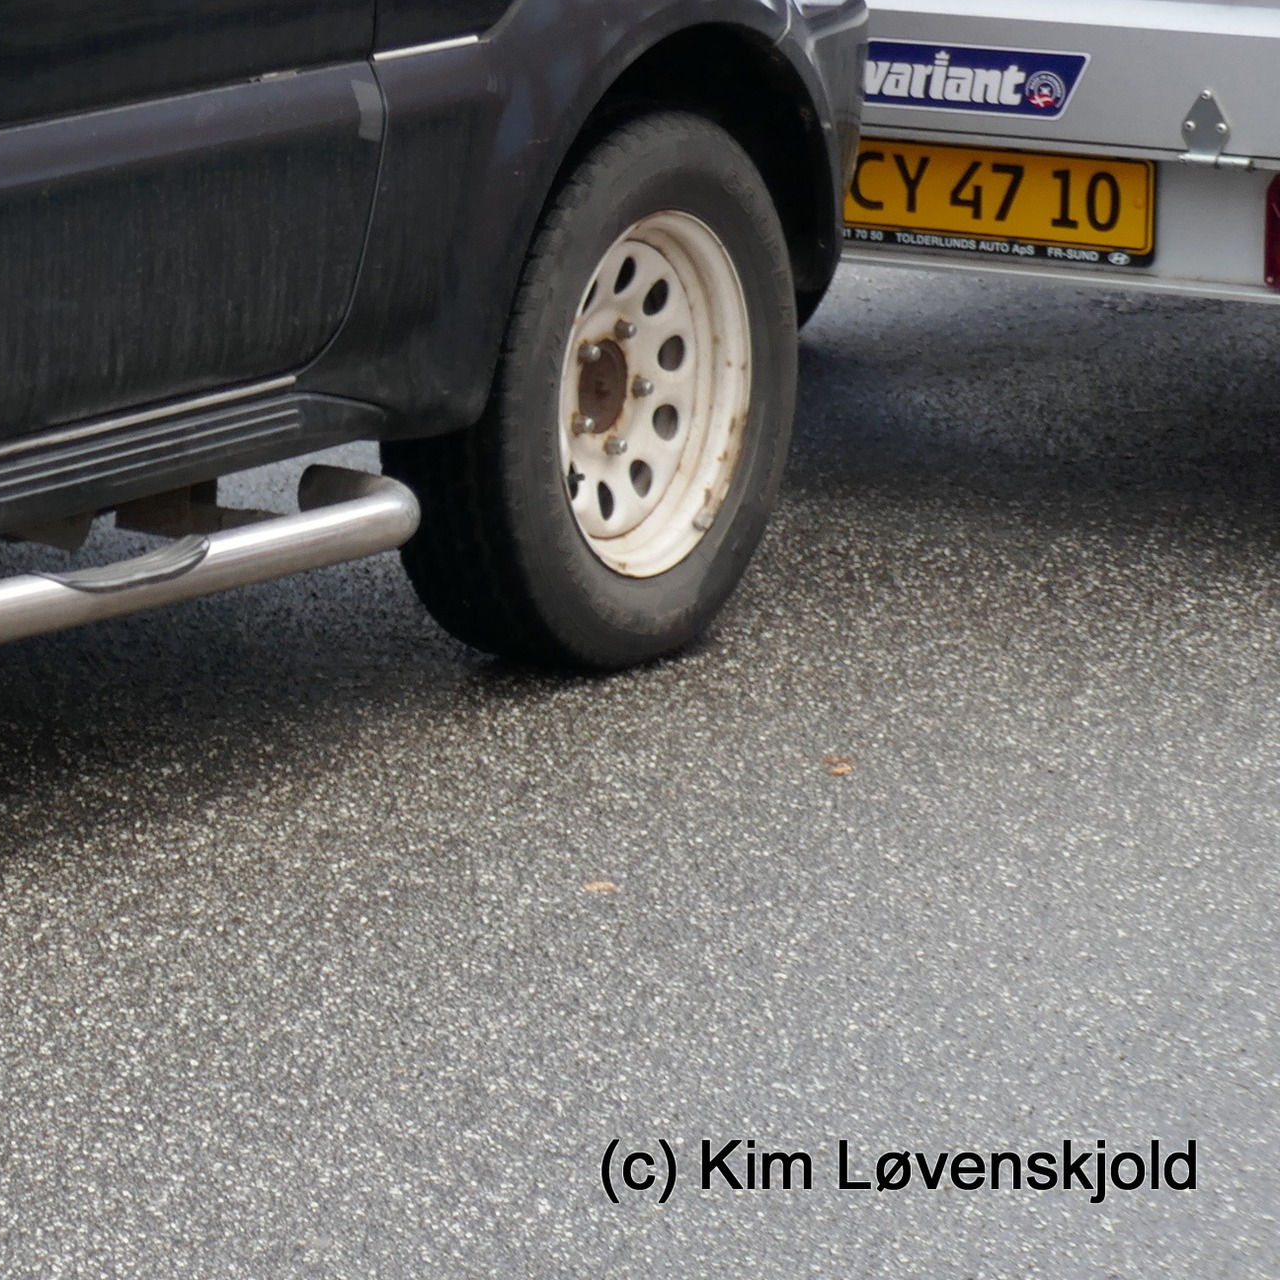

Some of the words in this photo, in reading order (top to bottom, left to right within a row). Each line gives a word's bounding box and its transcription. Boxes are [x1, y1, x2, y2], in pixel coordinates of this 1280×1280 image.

[864, 50, 1026, 106] variant
[850, 151, 930, 213] CY
[949, 161, 1025, 221] 47
[1050, 169, 1121, 232] 10
[854, 228, 868, 240] 70
[895, 232, 977, 250] TOLDERLUNDS
[978, 240, 1010, 254] AUTO
[1012, 244, 1035, 256] ApS
[1047, 246, 1099, 262] FR-SUND
